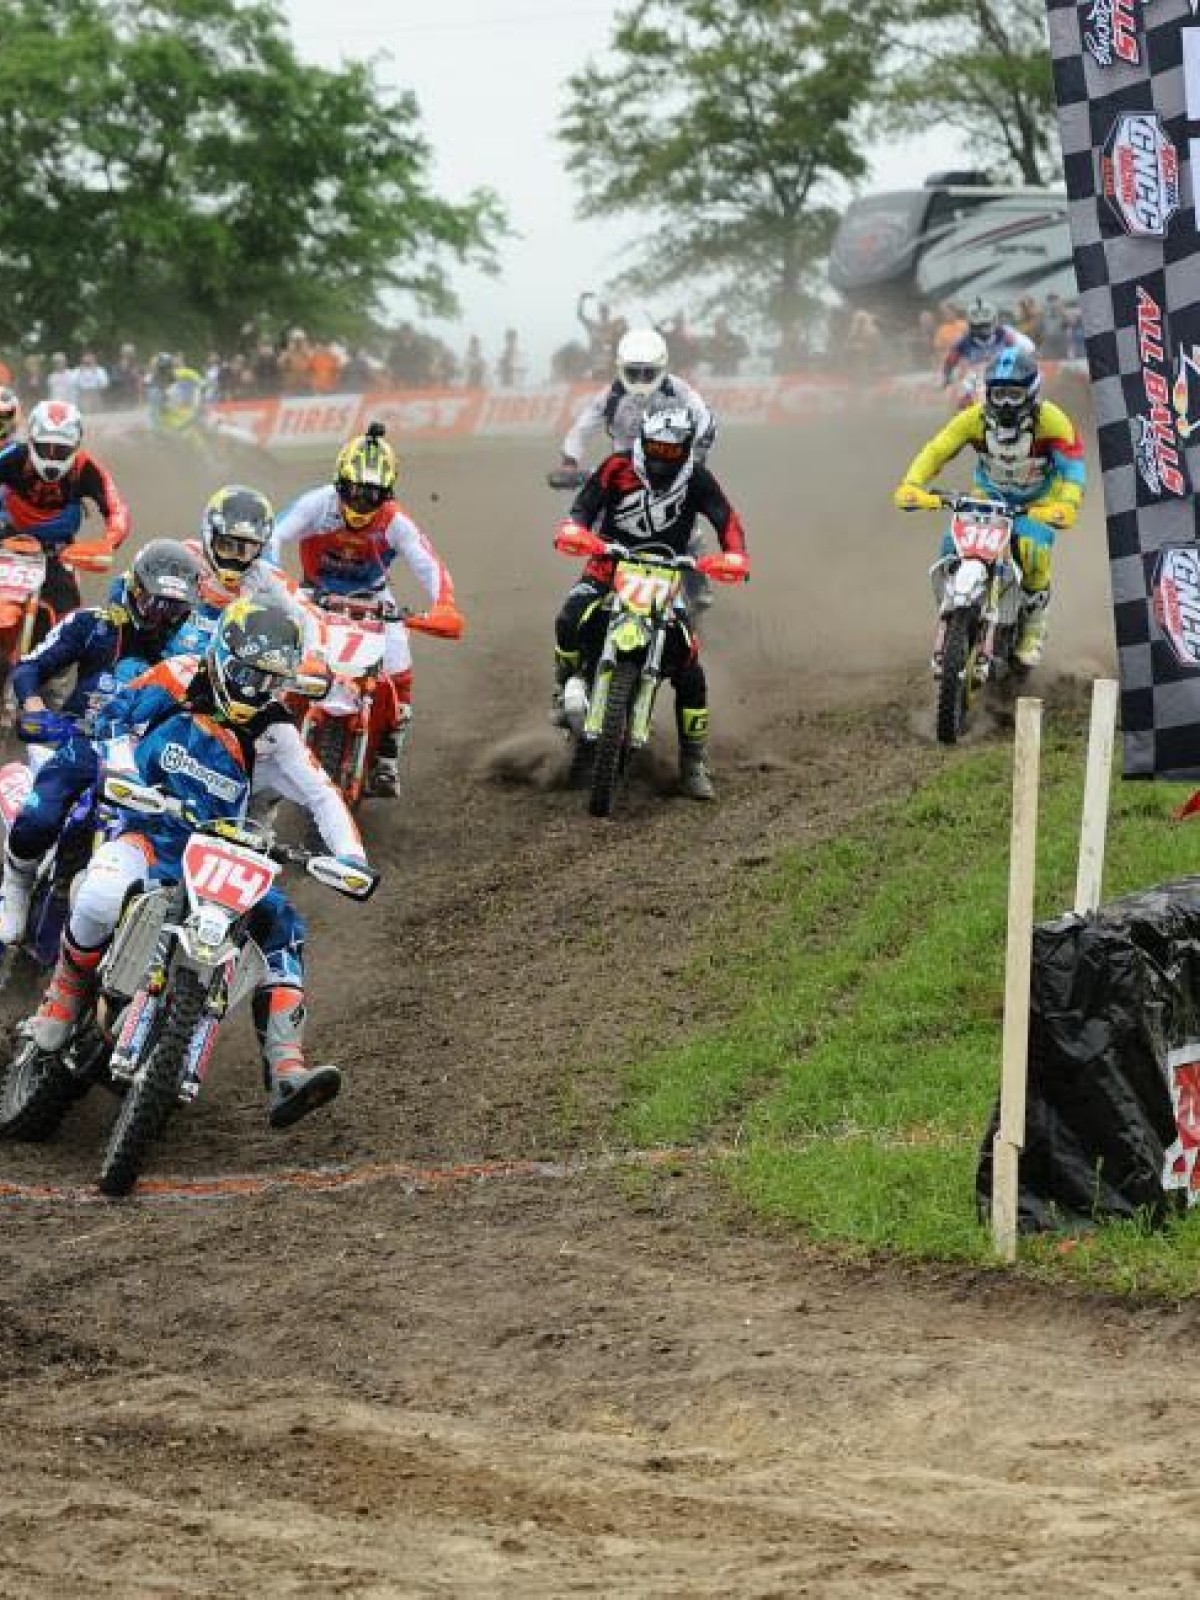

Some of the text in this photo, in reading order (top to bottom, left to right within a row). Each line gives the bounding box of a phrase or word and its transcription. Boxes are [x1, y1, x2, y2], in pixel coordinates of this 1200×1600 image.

[1129, 117, 1163, 230] GNCC
[1135, 284, 1184, 496] ALL BALLS
[279, 404, 352, 437] TIRES
[337, 632, 364, 662] 7
[191, 853, 265, 906] 114
